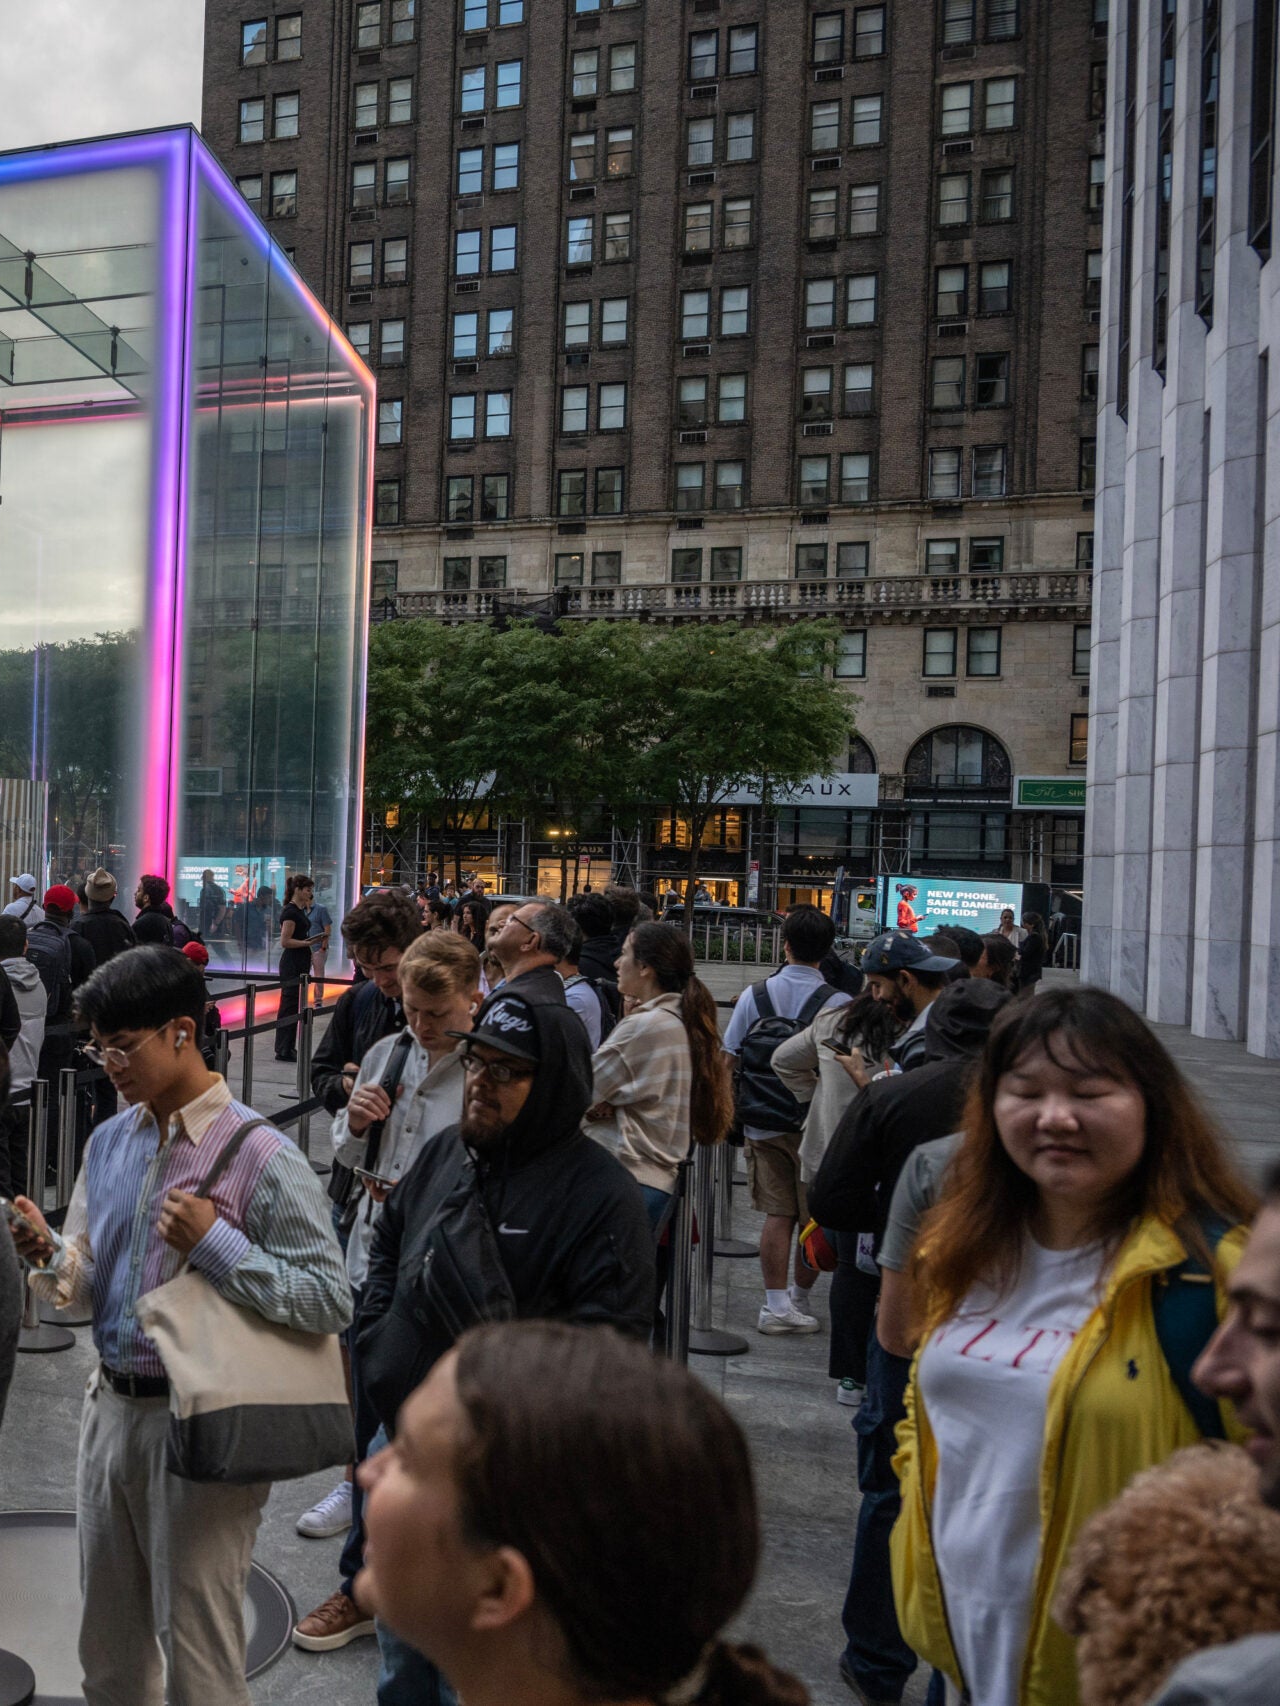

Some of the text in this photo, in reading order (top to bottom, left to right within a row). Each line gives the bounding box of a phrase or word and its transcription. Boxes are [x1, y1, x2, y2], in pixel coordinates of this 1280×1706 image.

[727, 783, 852, 796] DELVAUX
[552, 845, 604, 854] DLVAUX
[927, 890, 1000, 902] NEW PHONE,
[926, 898, 1016, 910] SAME DANGERS
[926, 907, 979, 917] FOR KIDS
[480, 1002, 533, 1032] Kings
